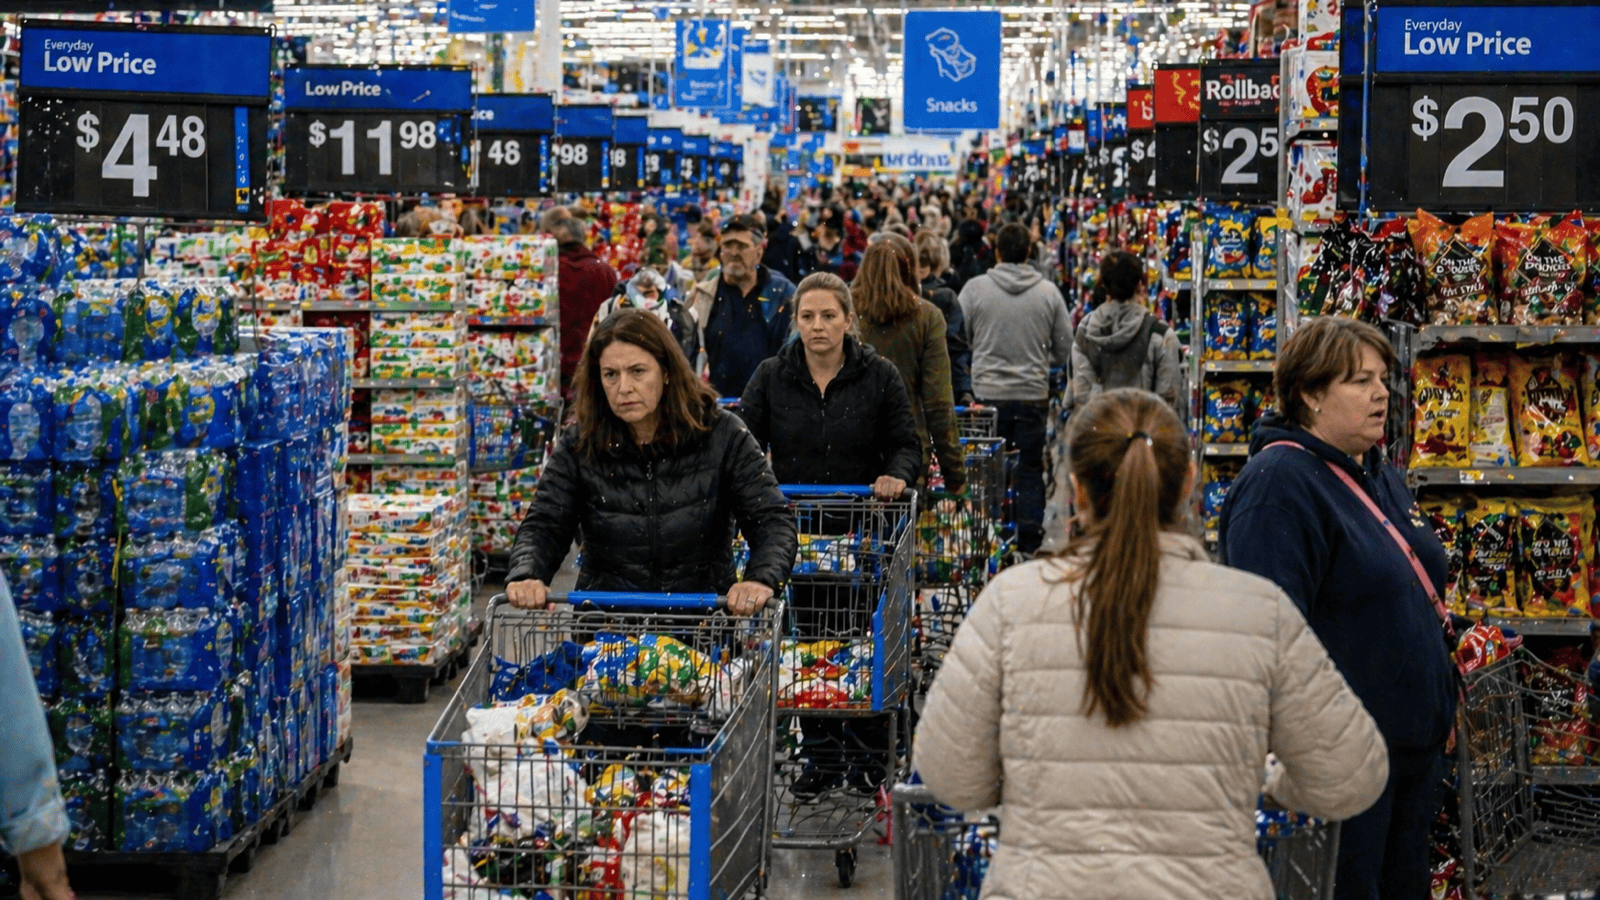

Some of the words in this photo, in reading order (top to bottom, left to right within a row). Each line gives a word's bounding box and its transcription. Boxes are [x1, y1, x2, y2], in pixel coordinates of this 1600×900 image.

[1405, 18, 1462, 33] Everyday
[44, 39, 94, 54] Everyday
[1404, 32, 1460, 55] Low
[1467, 31, 1532, 55] Price
[44, 51, 94, 73] Low
[97, 52, 157, 75] Price
[305, 80, 340, 96] Low
[341, 80, 382, 97] Price
[926, 97, 978, 113] Snacks
